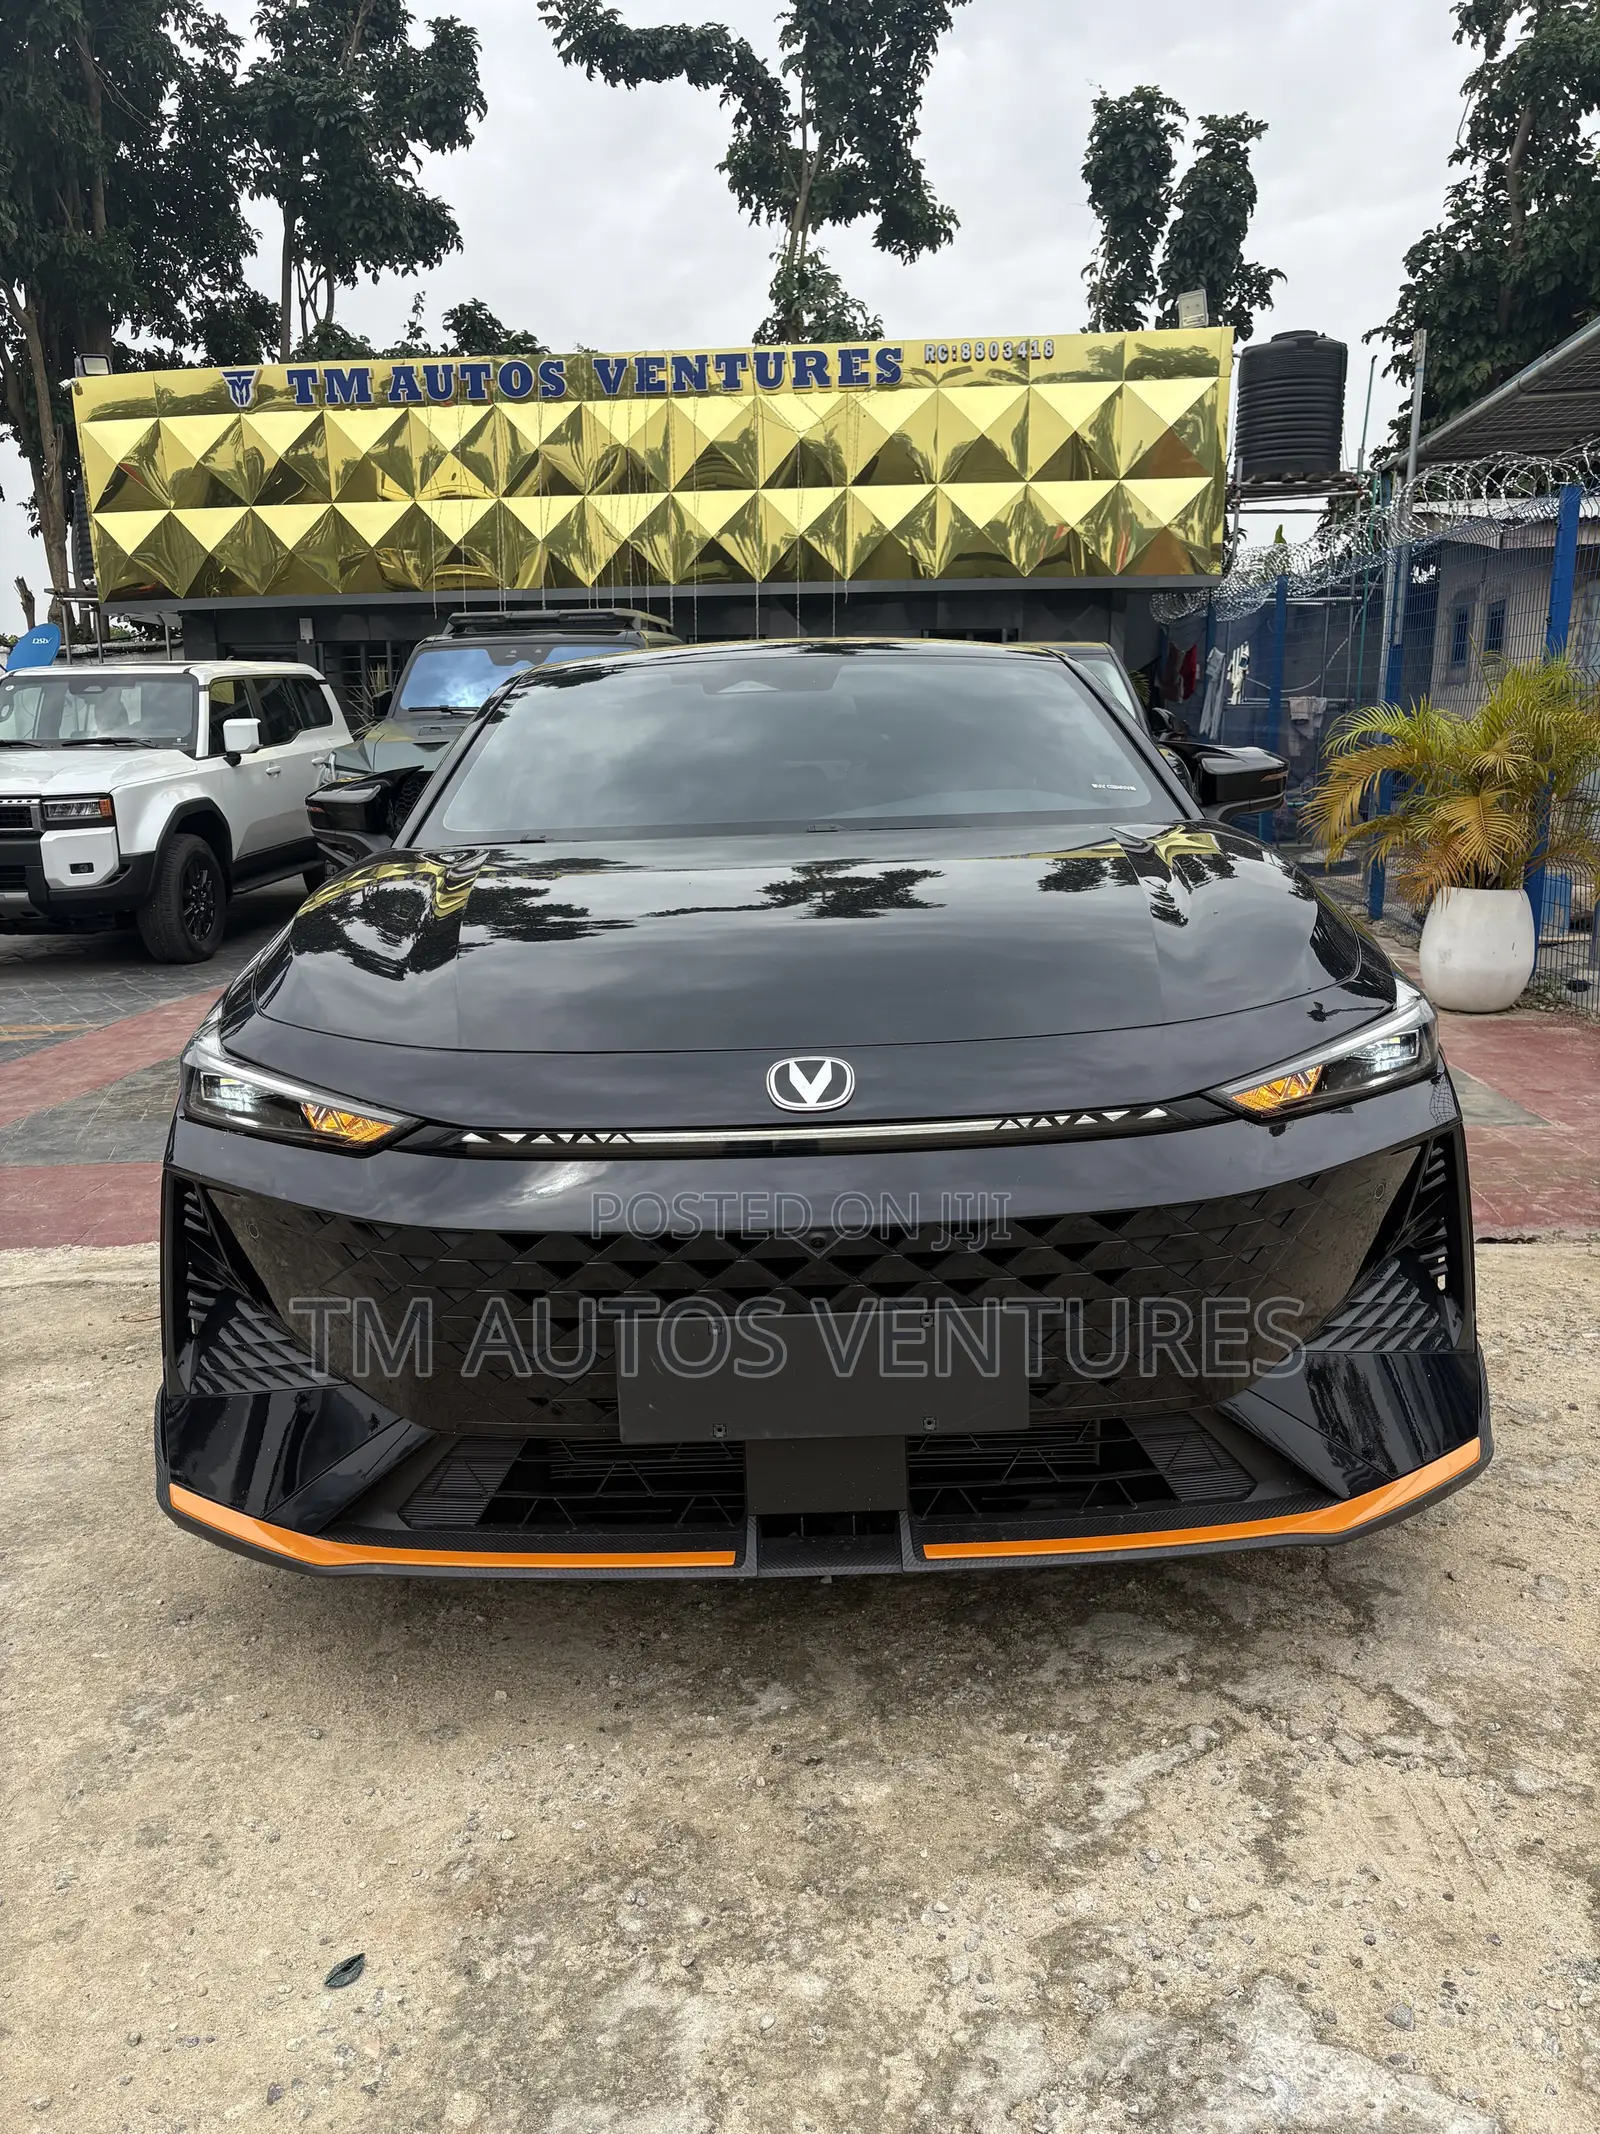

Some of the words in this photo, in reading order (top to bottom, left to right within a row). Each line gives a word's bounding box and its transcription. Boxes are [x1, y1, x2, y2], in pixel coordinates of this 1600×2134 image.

[924, 339, 1055, 363] RC:8803418
[287, 367, 374, 405] TM
[388, 359, 568, 403] AUTOS
[592, 347, 903, 395] VENTURES
